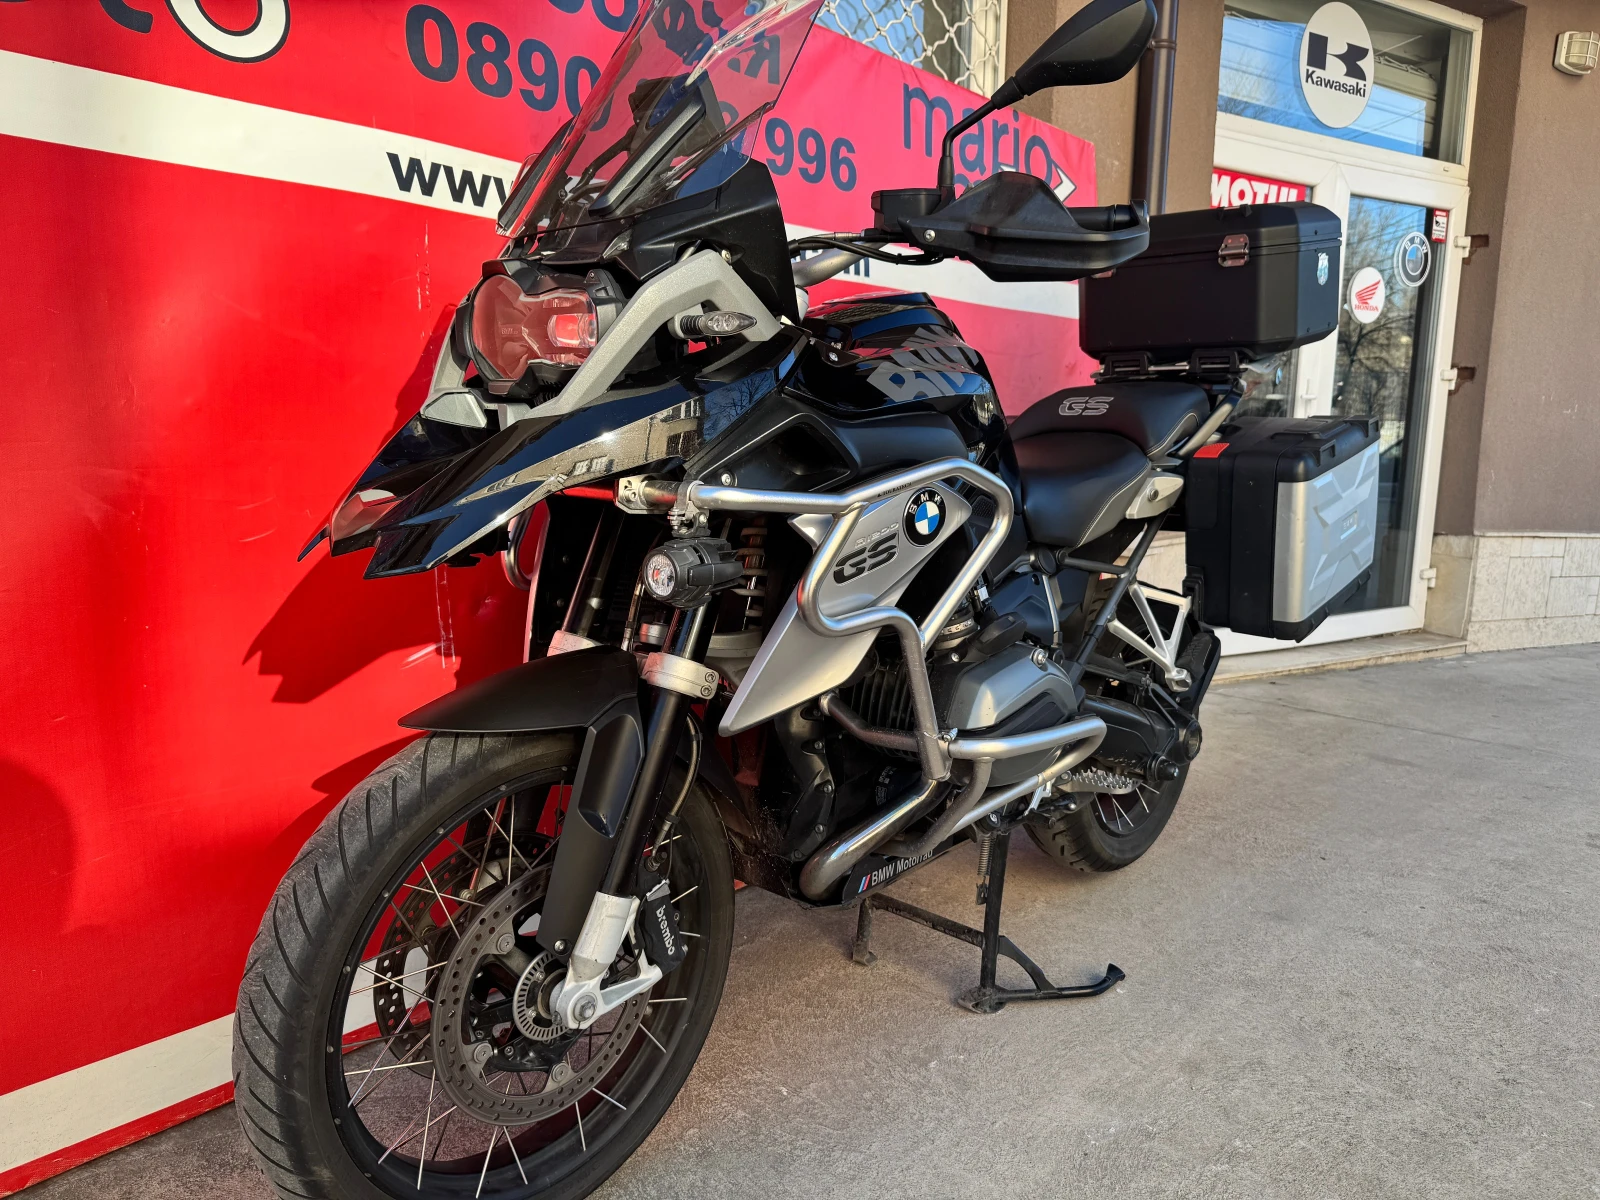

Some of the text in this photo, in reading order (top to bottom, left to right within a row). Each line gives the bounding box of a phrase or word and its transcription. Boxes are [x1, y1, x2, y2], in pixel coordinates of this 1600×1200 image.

[1305, 69, 1367, 98] Kawasaki
[903, 83, 1053, 182] mario
[764, 118, 857, 192] 996
[1404, 236, 1428, 254] BMW
[1354, 304, 1380, 312] HONDA
[1059, 396, 1115, 416] GS
[908, 491, 943, 515] BMW
[833, 531, 899, 586] GS
[871, 861, 895, 887] BMW
[655, 904, 675, 956] brembo
